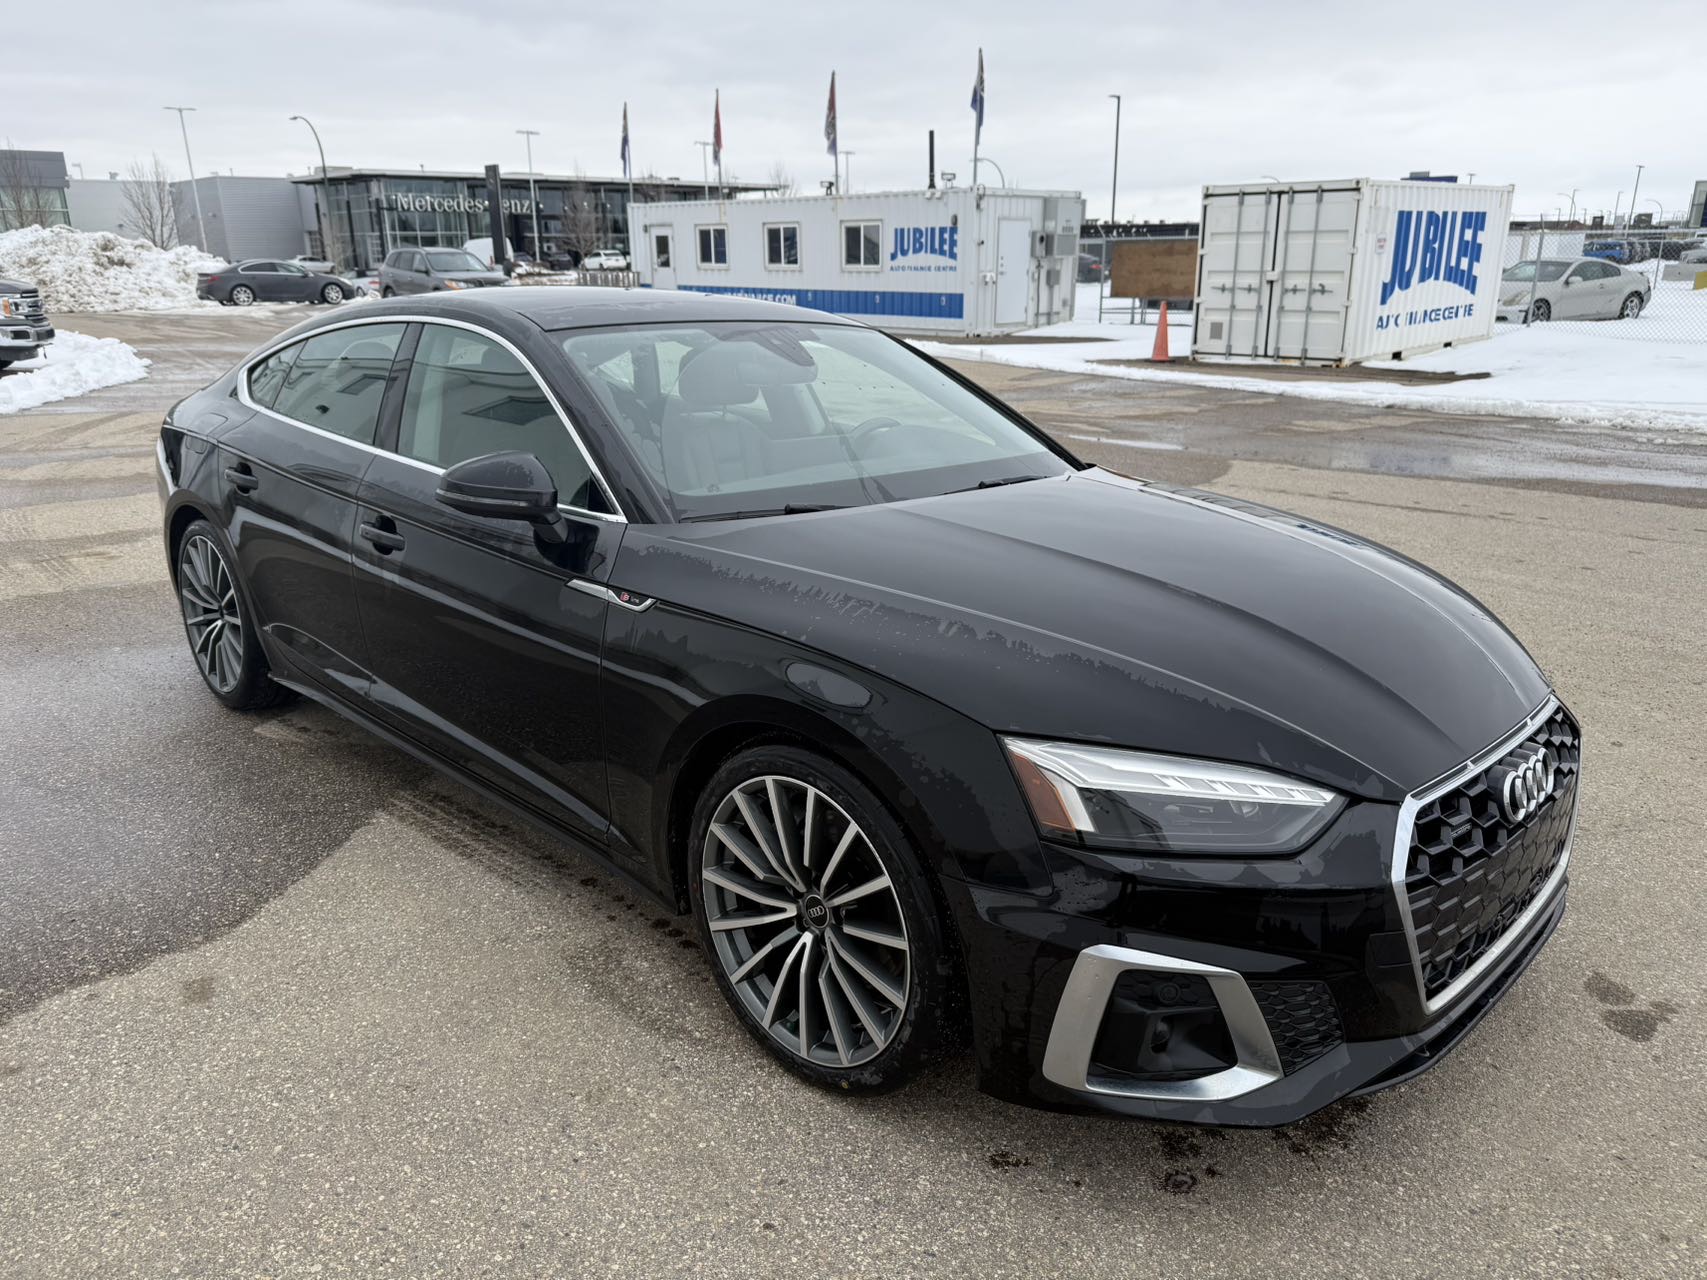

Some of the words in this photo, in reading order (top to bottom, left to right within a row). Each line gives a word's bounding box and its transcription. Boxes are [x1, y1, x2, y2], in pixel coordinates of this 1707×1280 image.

[397, 192, 531, 214] Mercedes-enz
[890, 226, 958, 261] JUBILEE
[1380, 210, 1487, 305] JUBILEE
[1376, 312, 1400, 330] AUO
